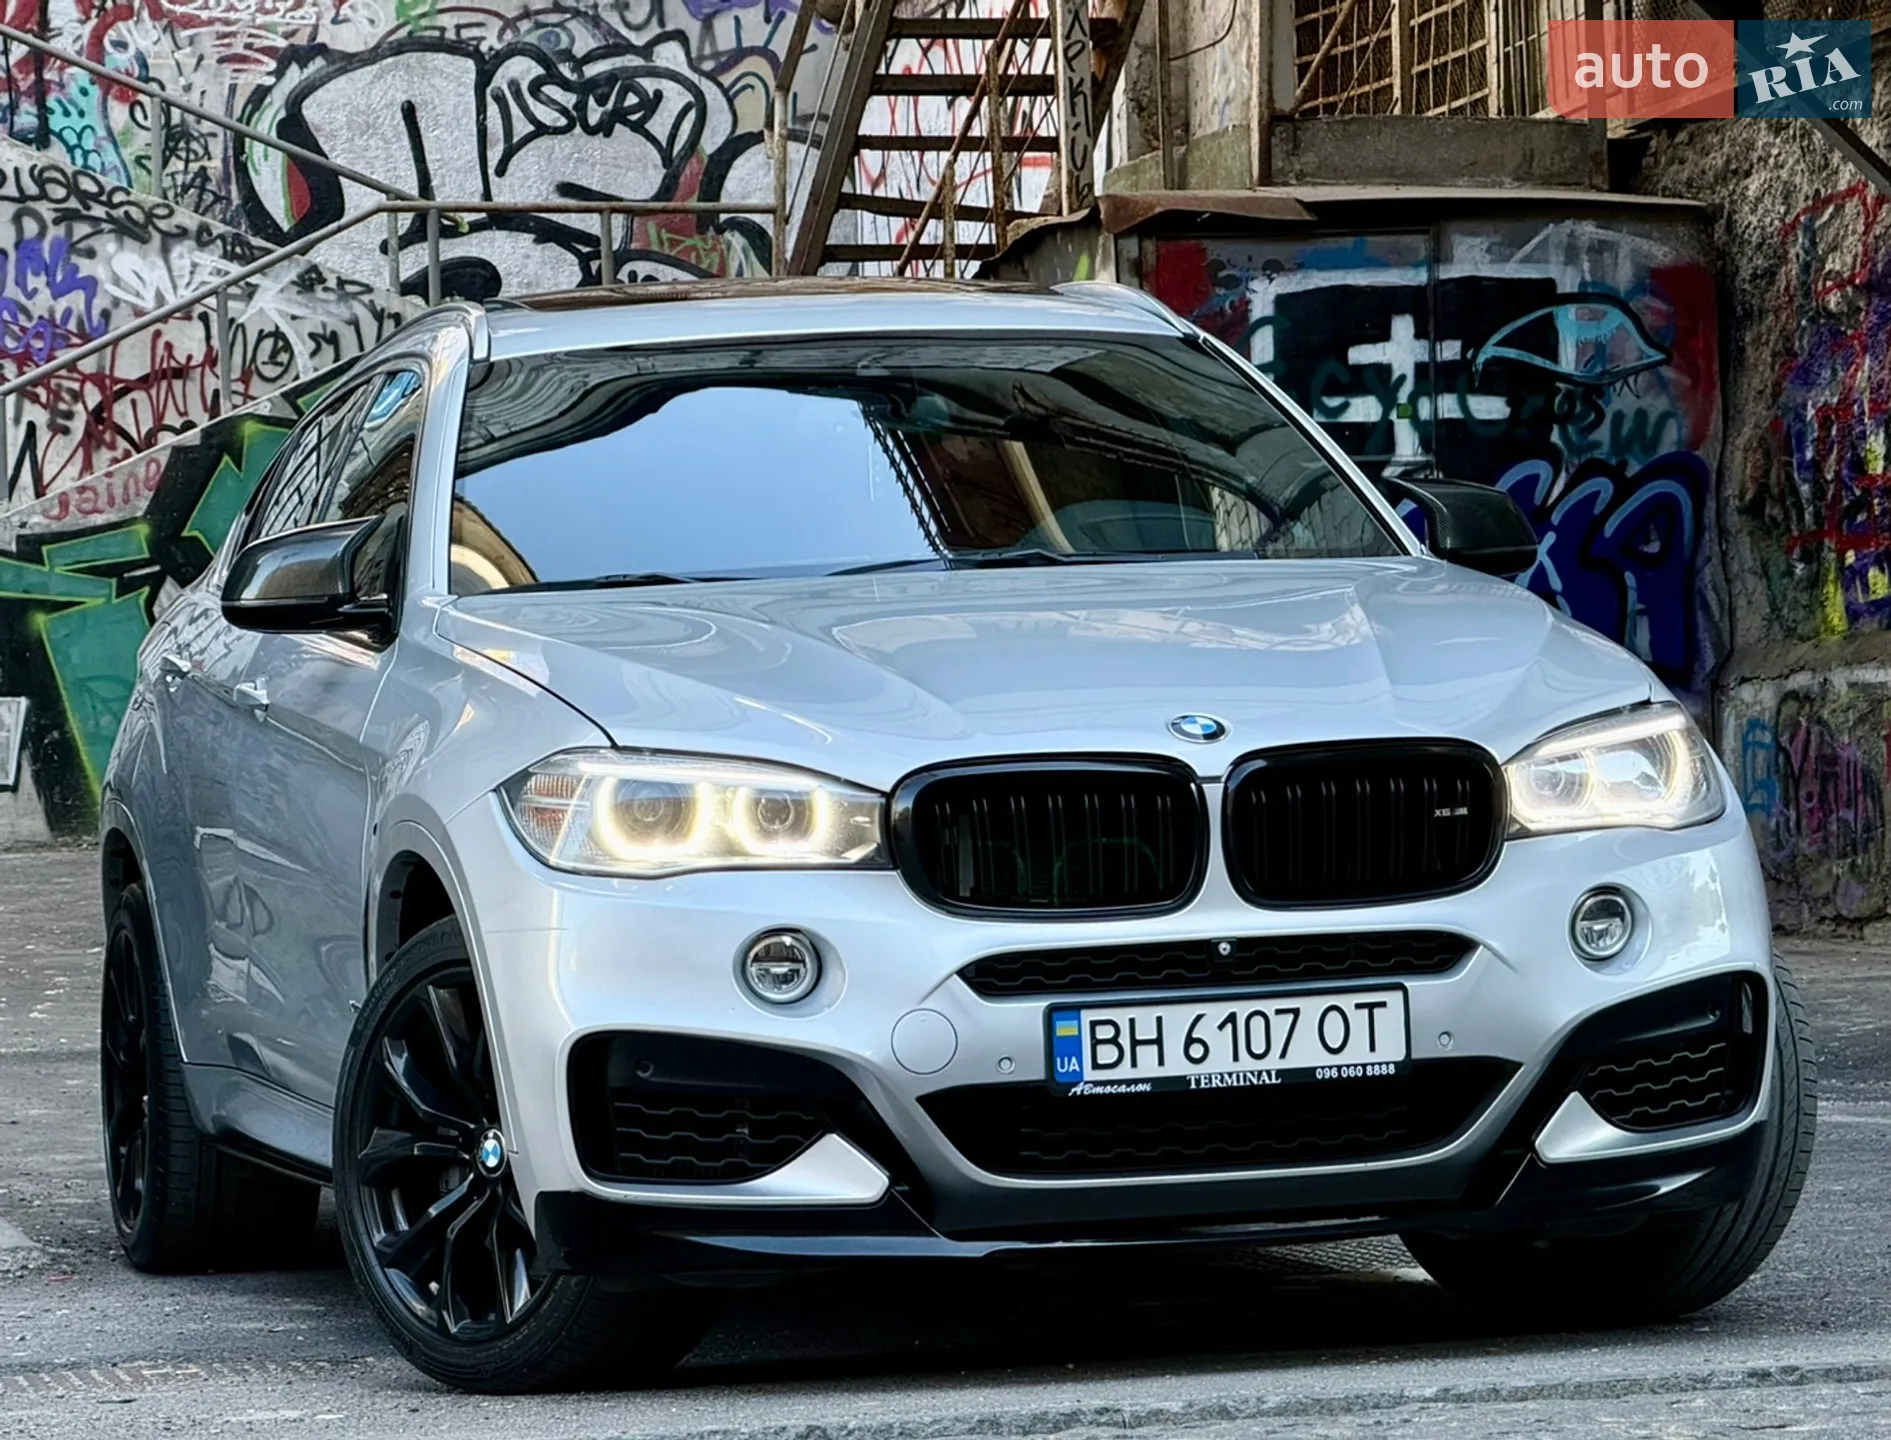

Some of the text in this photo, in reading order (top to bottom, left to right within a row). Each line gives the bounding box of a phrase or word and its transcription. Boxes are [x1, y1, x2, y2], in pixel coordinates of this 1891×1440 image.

[1088, 1000, 1388, 1071] BH 6107 OT
[1056, 1056, 1080, 1074] UA
[1315, 1063, 1396, 1079] 096 060 8888
[1186, 1069, 1282, 1090] TERMINAL
